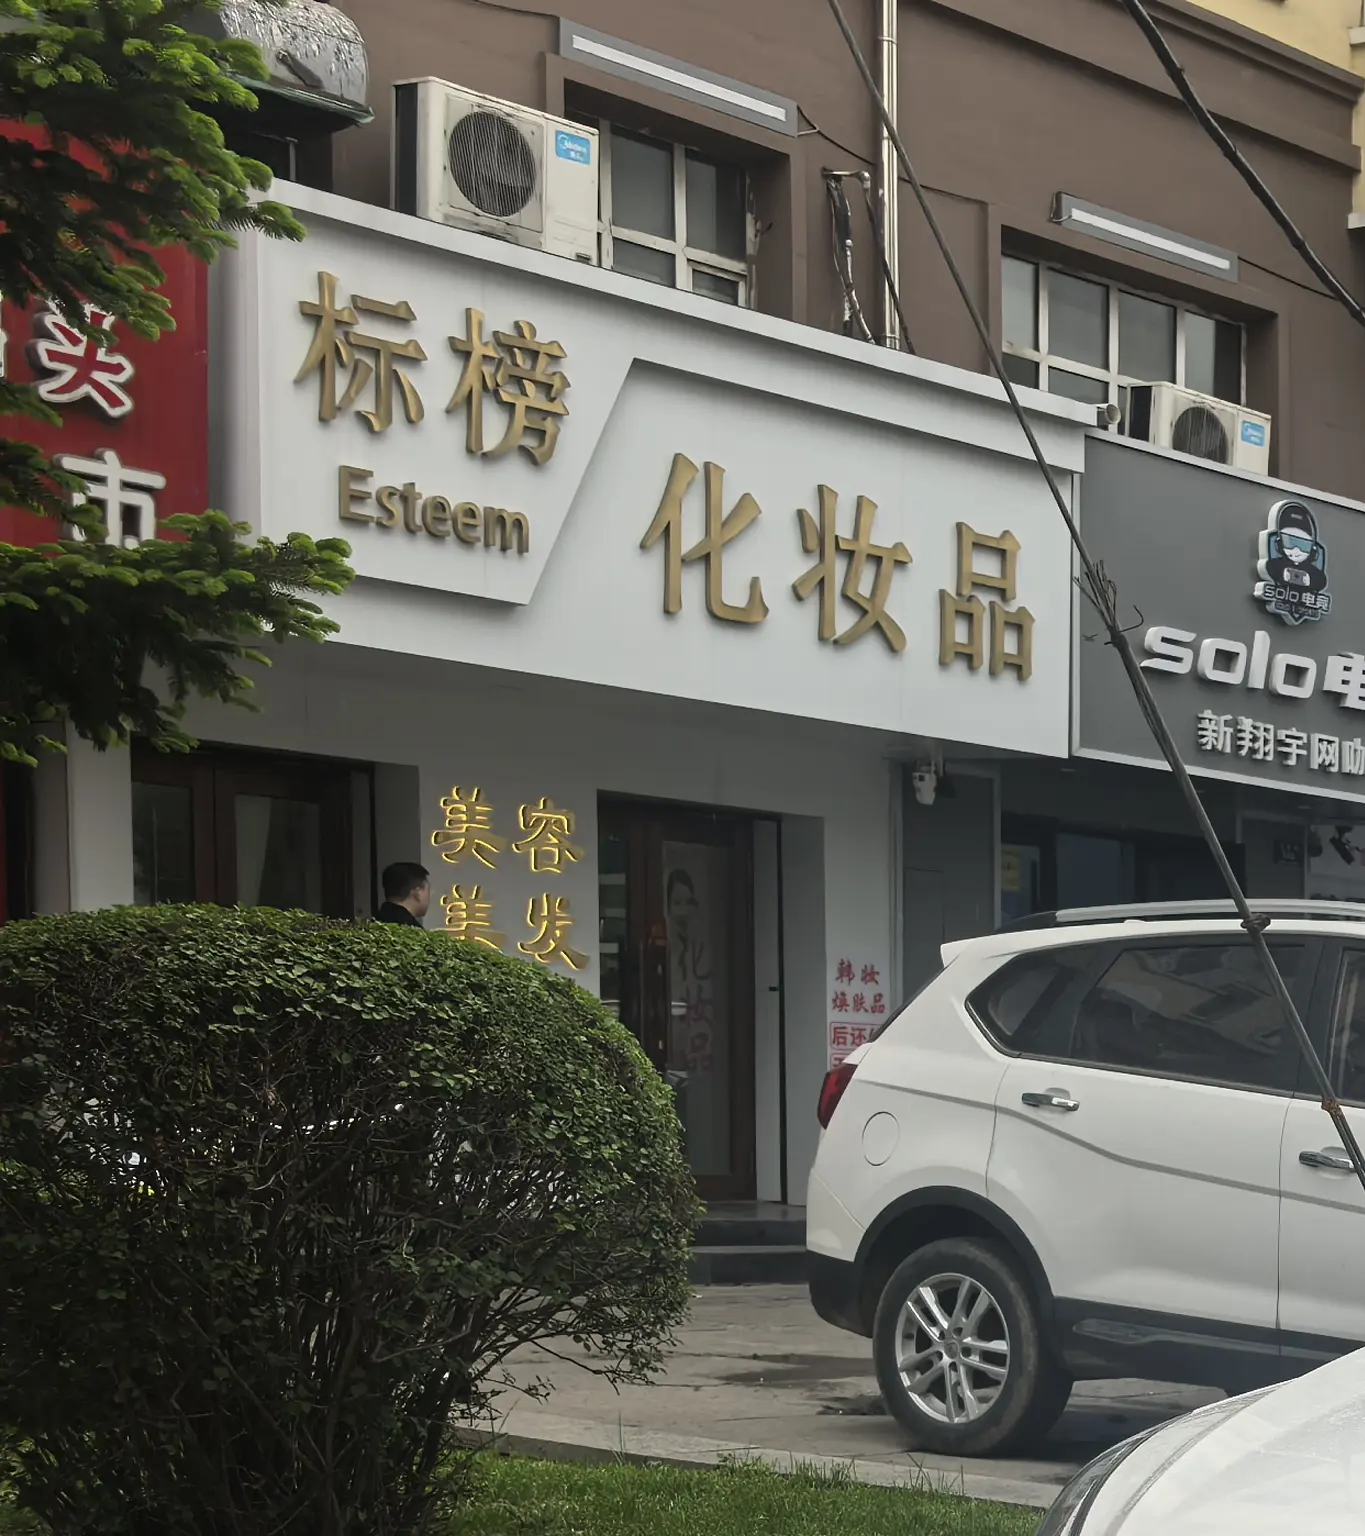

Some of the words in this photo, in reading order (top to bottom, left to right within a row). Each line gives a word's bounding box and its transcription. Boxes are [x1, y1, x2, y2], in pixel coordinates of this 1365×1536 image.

[293, 271, 572, 466] 标榜
[338, 465, 530, 554] Esteem
[640, 452, 1036, 682] 化妆品
[431, 785, 586, 875] 美容
[832, 1025, 877, 1048] 后还
